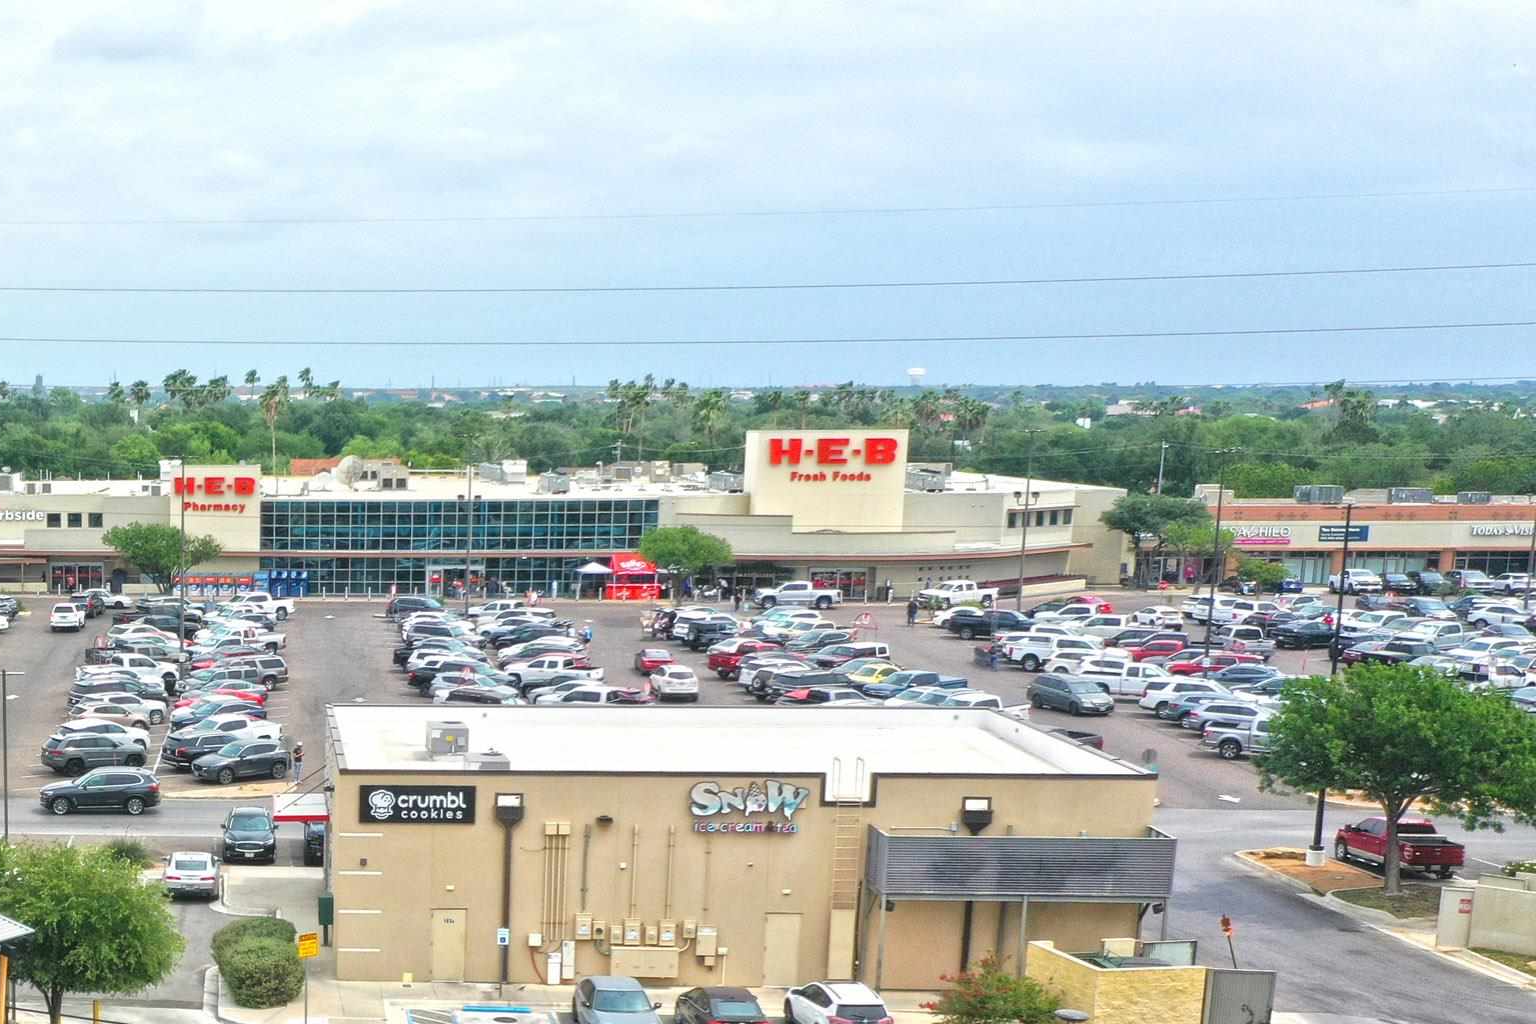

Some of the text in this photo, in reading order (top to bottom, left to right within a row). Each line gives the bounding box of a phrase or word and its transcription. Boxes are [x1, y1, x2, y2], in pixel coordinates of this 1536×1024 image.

[769, 438, 898, 465] H-E-B
[790, 472, 872, 482] Fresh Foods
[174, 477, 256, 496] H-E-B
[183, 502, 246, 513] Pharmacy
[397, 791, 467, 808] crumbl
[401, 809, 464, 819] cookies
